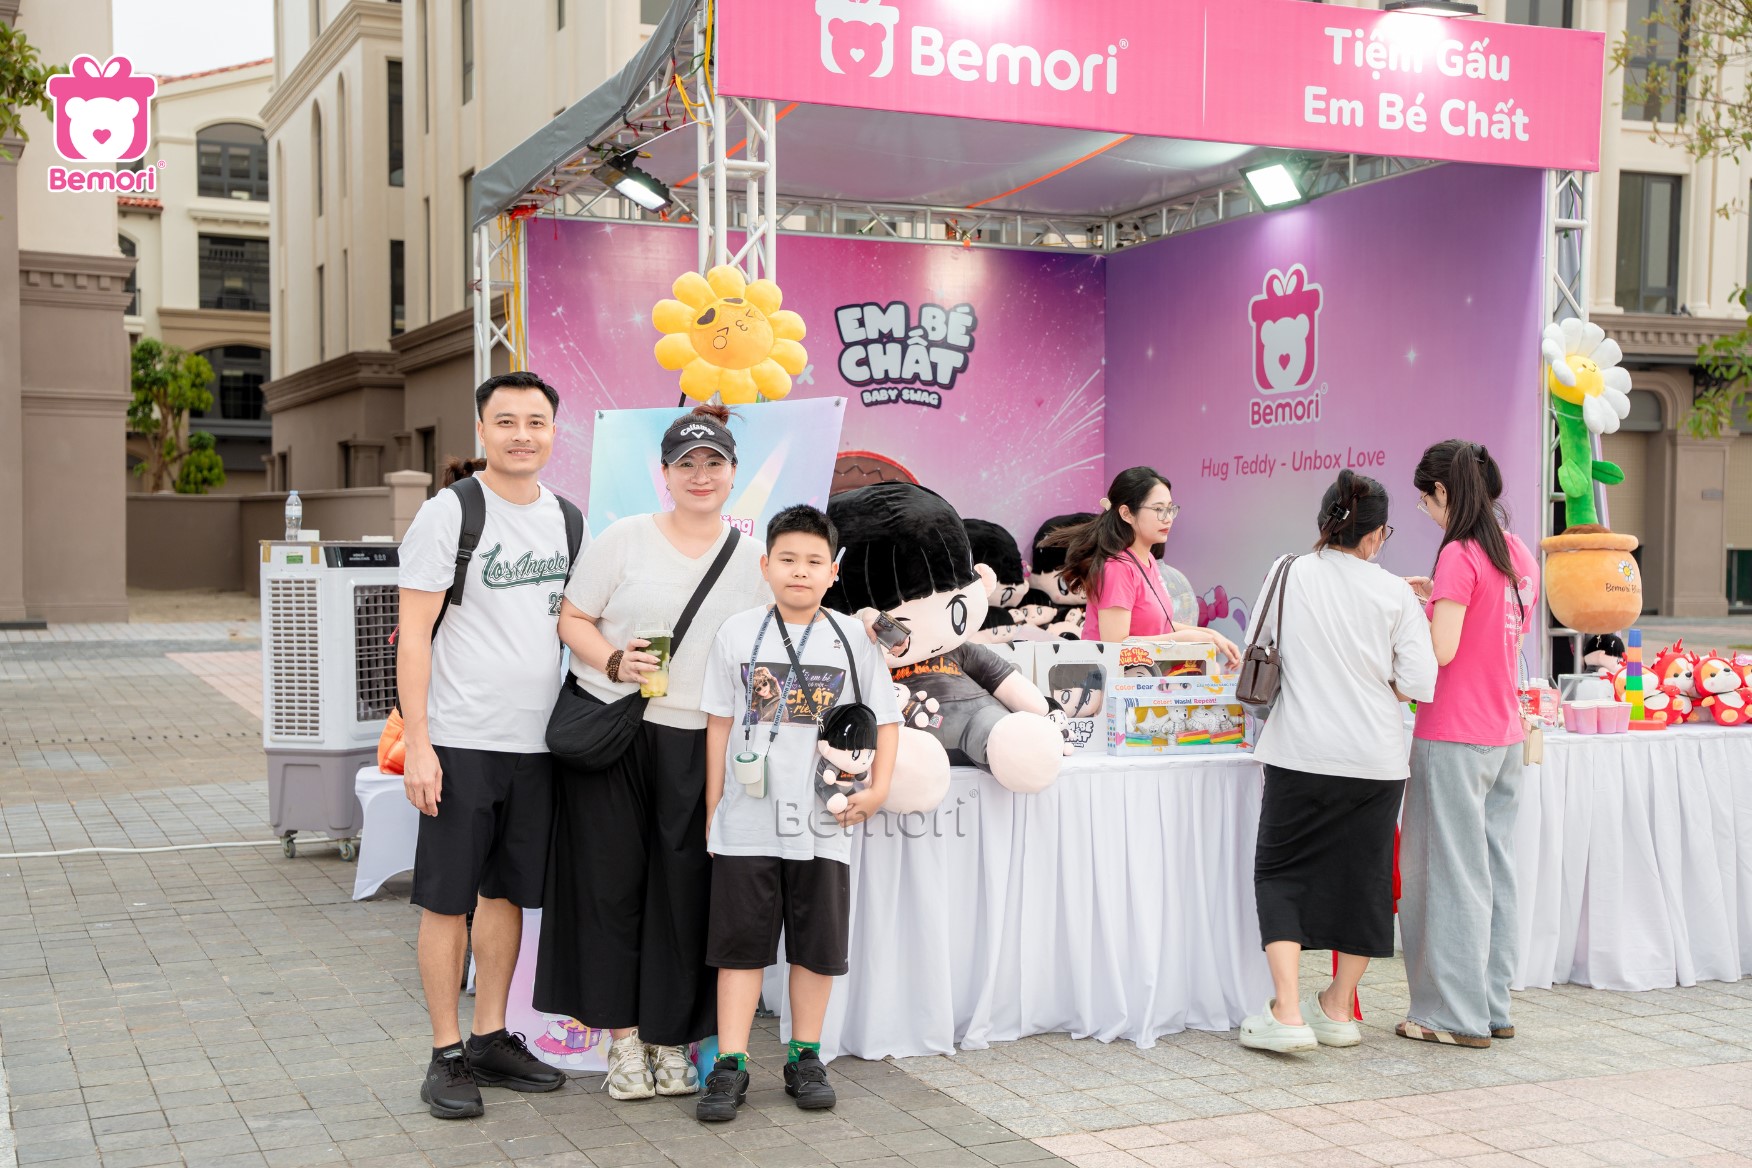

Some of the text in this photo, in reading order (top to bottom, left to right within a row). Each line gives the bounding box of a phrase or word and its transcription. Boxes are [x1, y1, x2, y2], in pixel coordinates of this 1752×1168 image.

[911, 26, 1117, 95] Bemori
[1436, 37, 1510, 81] Gấu
[1304, 85, 1530, 141] Em Bé Chất
[836, 303, 974, 347] EM BÉ
[840, 328, 965, 385] CHẤT
[862, 388, 939, 405] BABY SWAG
[1250, 392, 1320, 427] Bemori
[1201, 458, 1229, 481] Hug
[1234, 453, 1276, 478] Teddy
[1292, 450, 1341, 471] Unbox
[1347, 446, 1385, 468] Love
[513, 551, 568, 580] Angele
